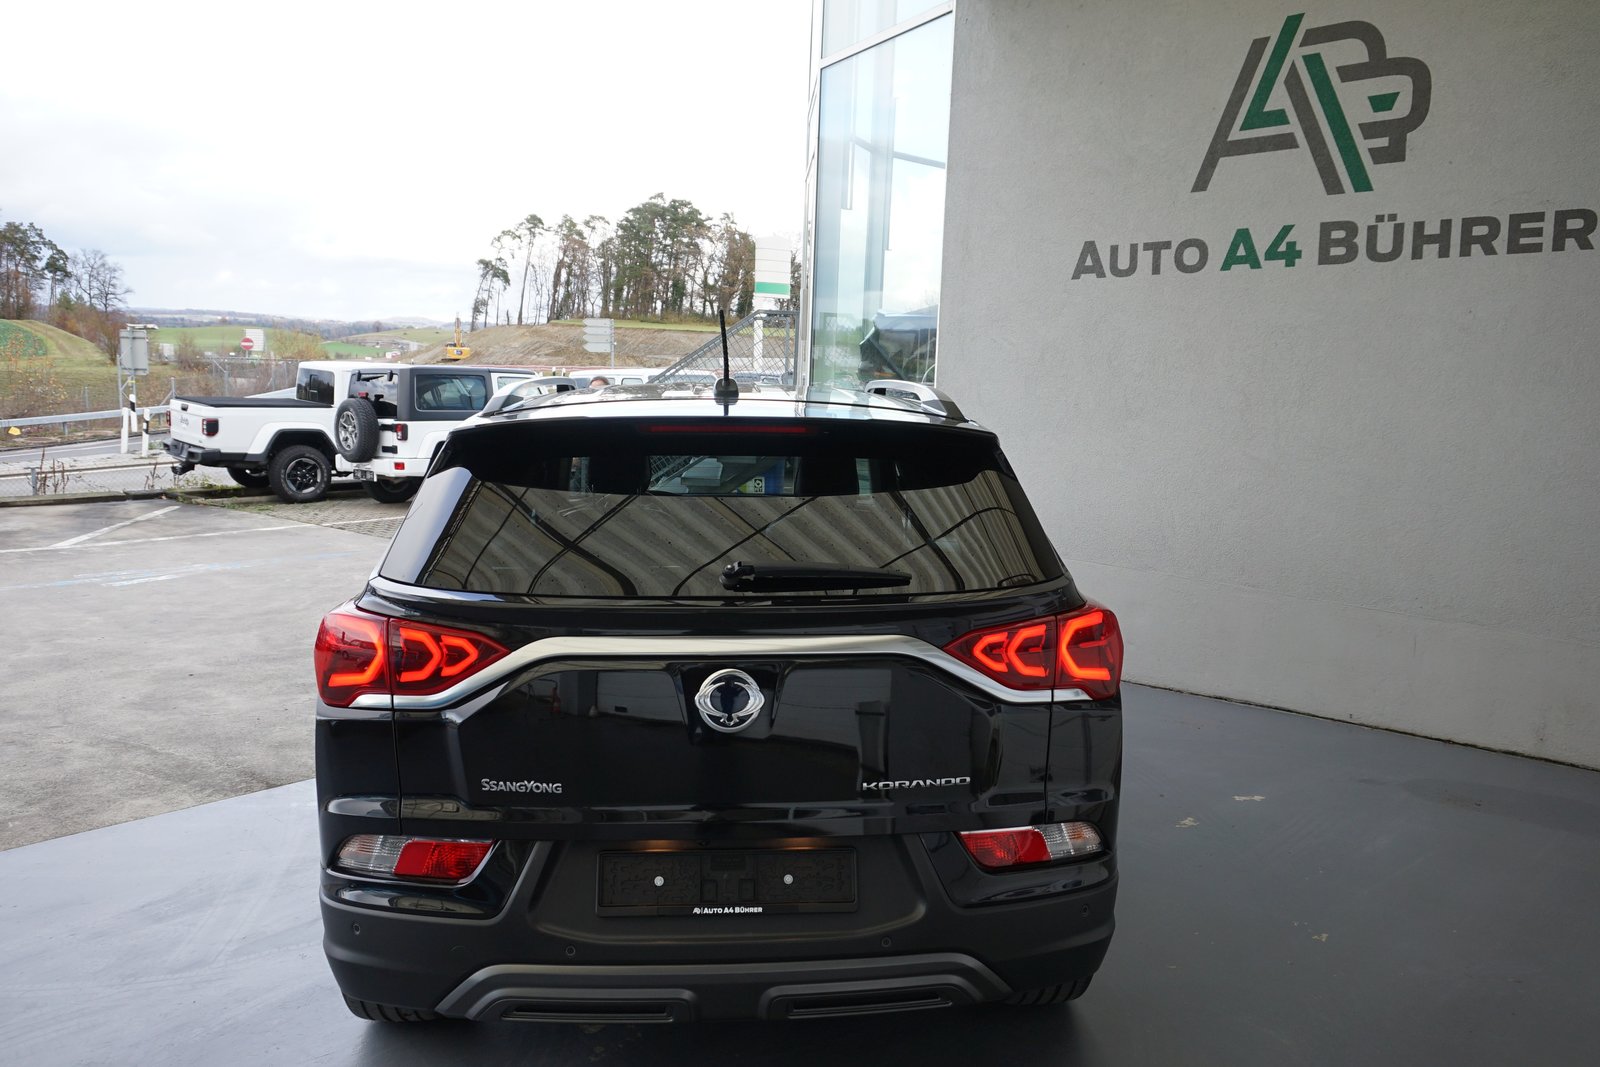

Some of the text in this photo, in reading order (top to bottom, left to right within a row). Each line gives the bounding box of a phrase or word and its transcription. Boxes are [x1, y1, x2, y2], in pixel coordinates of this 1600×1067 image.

[1071, 208, 1598, 280] AUTO A4 BÜHRER
[862, 776, 971, 791] KORANDO
[723, 906, 734, 914] A4
